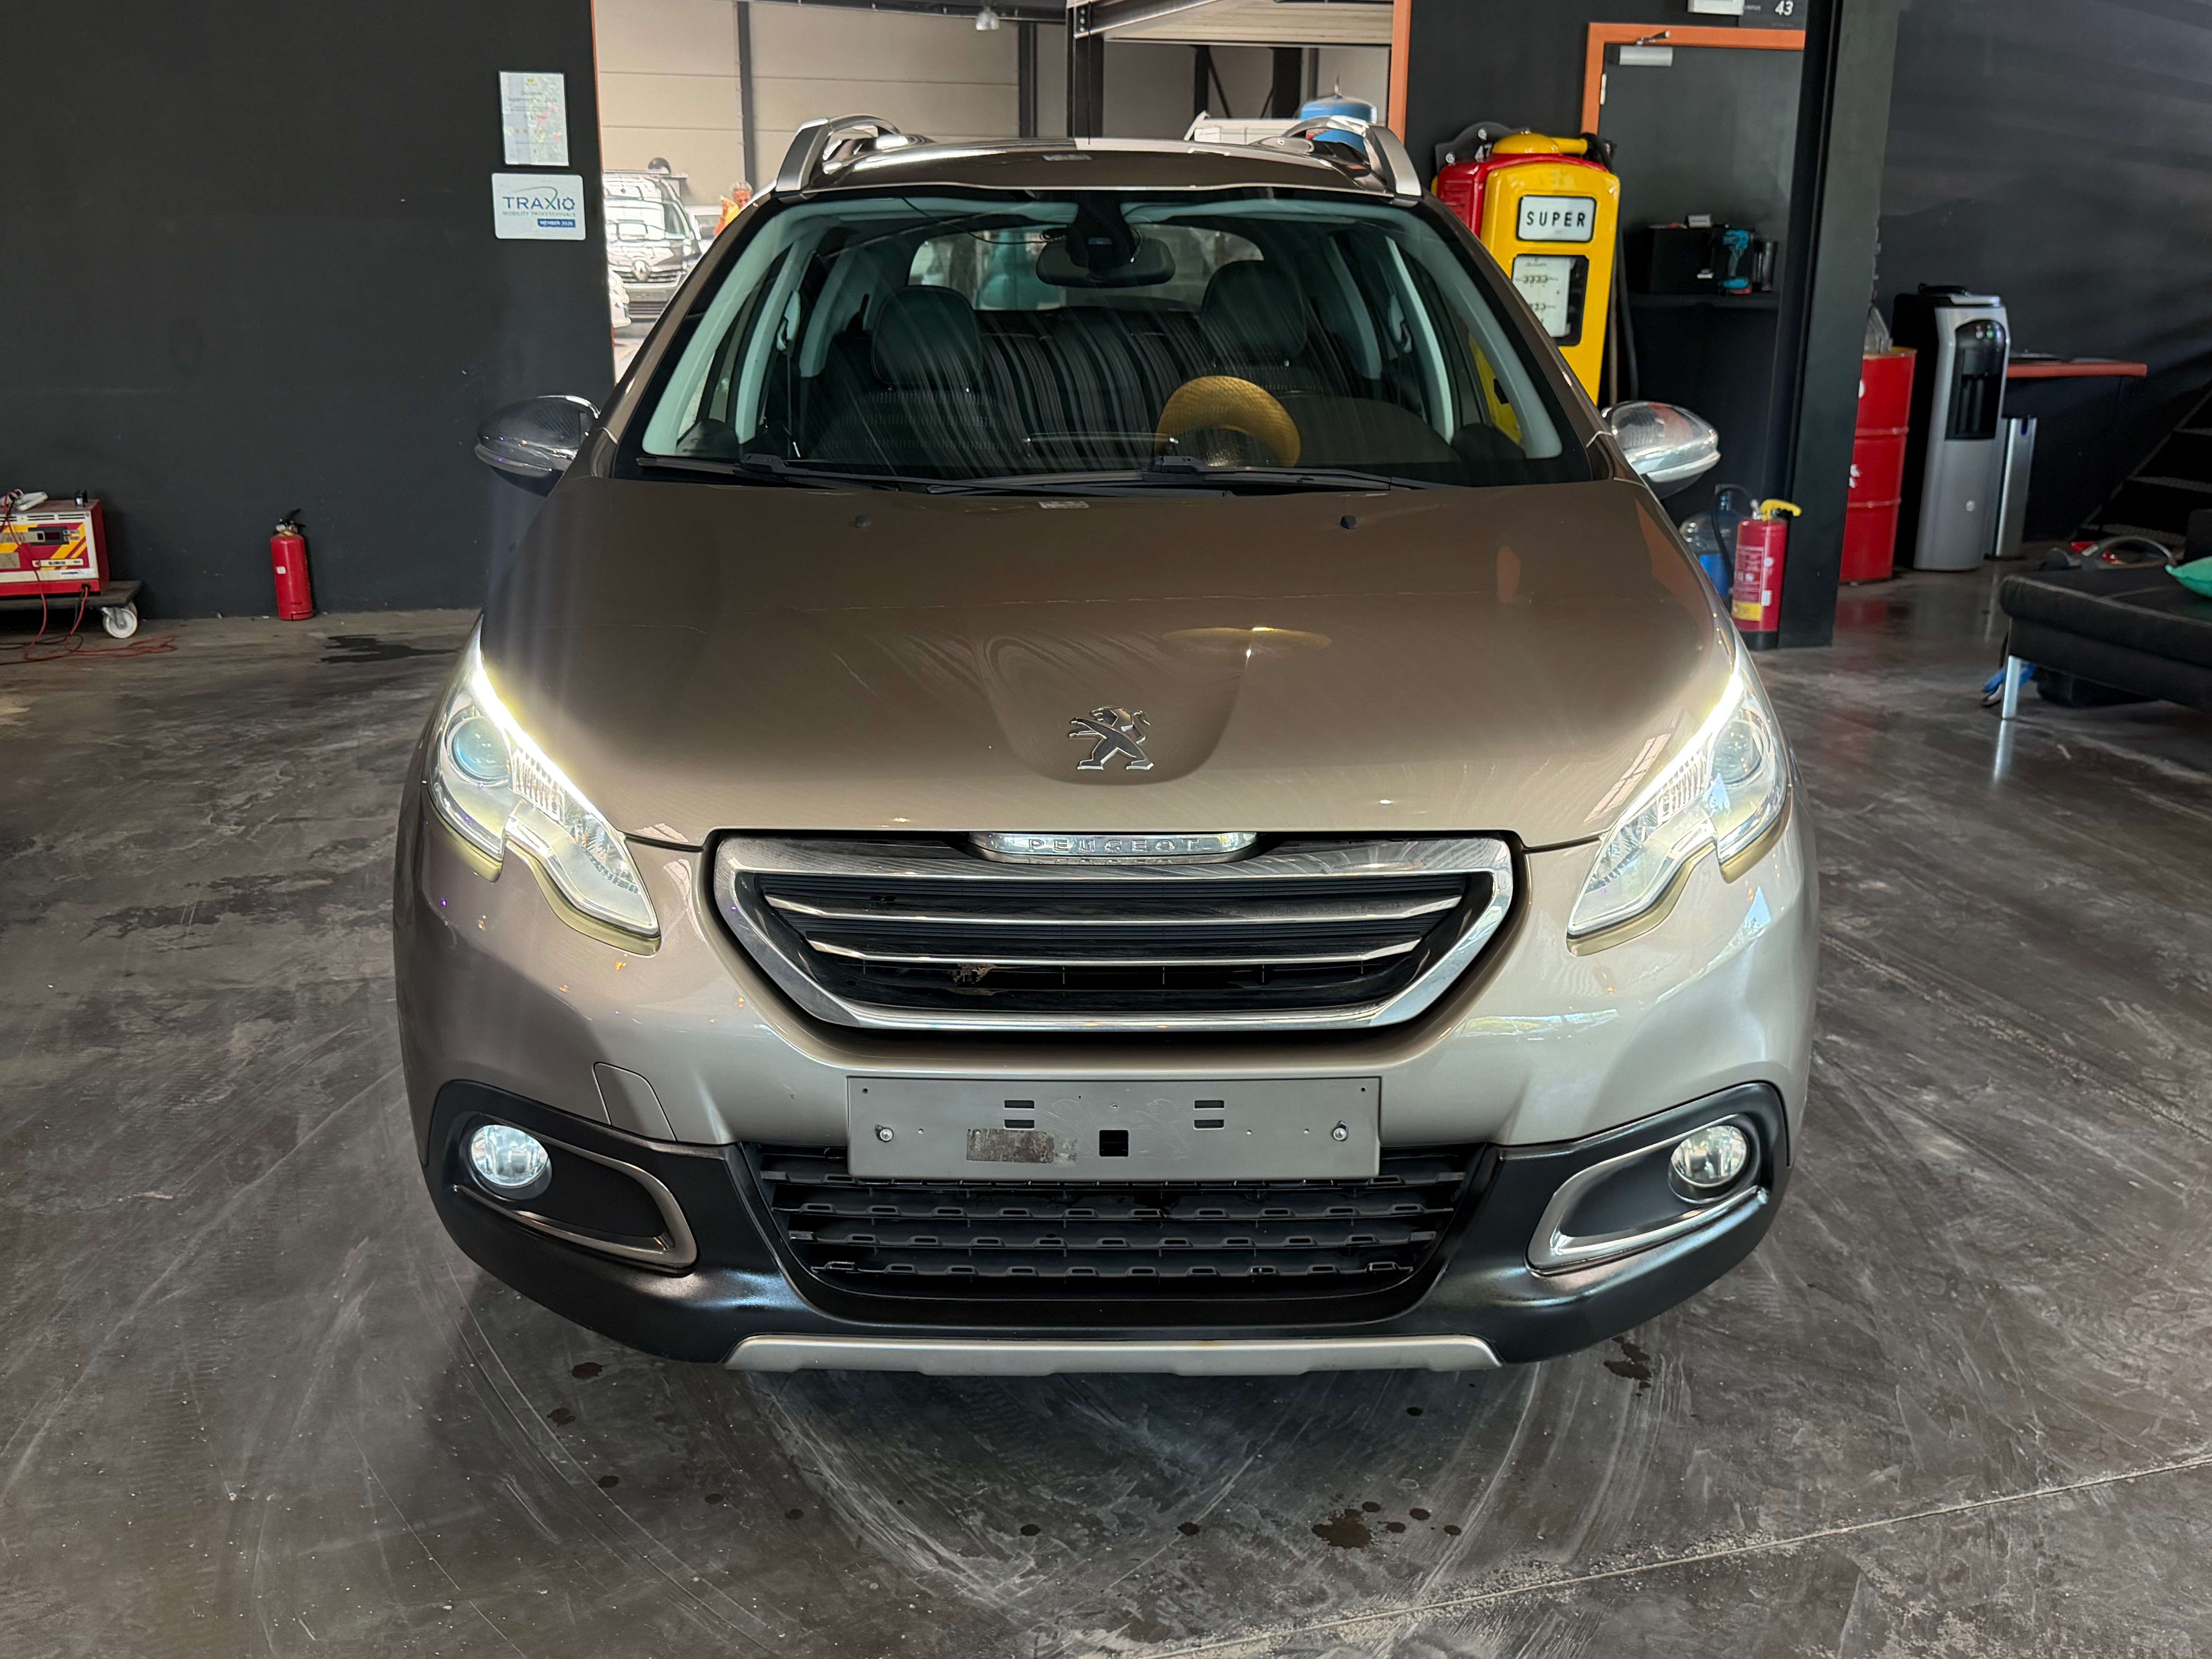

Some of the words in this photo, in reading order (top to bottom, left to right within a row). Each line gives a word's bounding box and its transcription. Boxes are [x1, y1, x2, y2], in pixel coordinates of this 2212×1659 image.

[1775, 0, 1794, 16] 43
[502, 196, 575, 211] TRAXIO
[1526, 211, 1585, 227] SUPER
[1028, 838, 1199, 853] PEUGEOT
